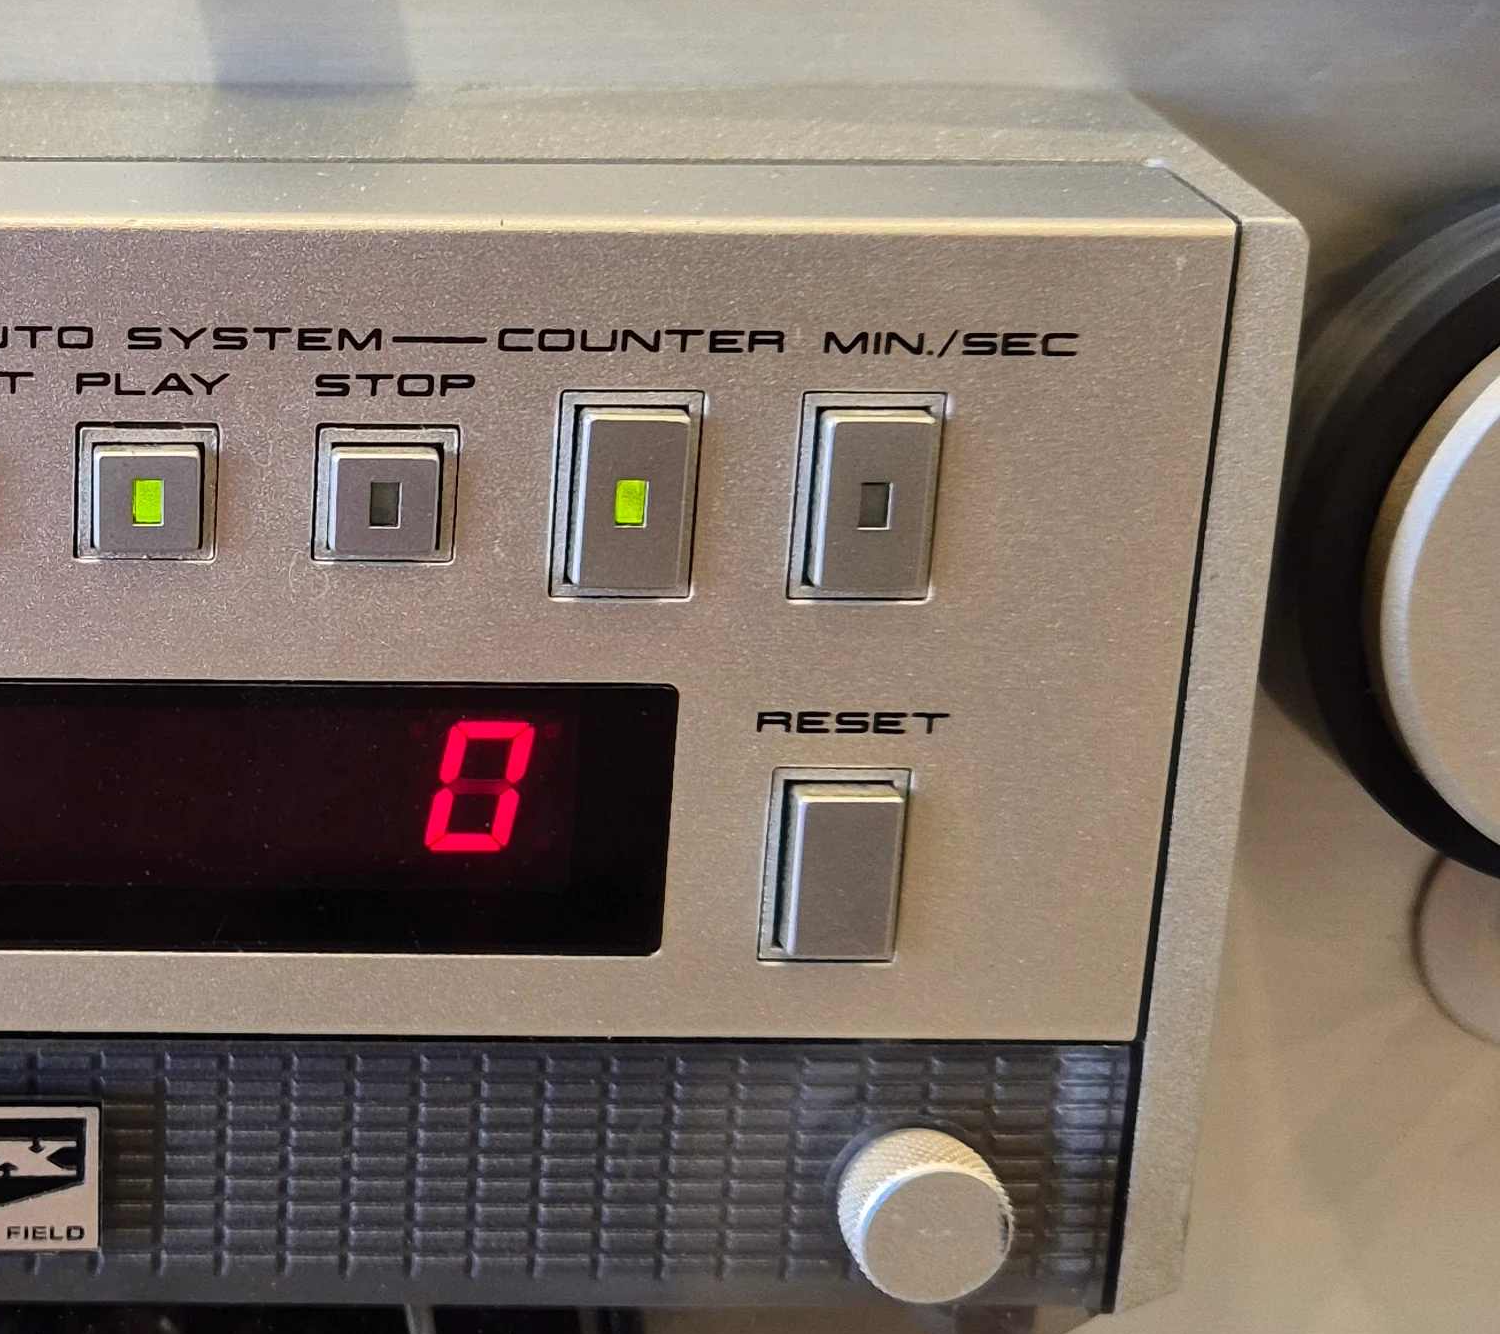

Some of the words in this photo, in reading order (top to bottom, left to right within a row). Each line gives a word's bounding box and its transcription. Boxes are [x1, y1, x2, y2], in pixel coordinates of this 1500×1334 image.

[128, 327, 383, 351] SYSTEM
[497, 328, 785, 354] COUNTER
[824, 330, 1080, 357] MIN./SEC
[75, 372, 231, 396] PLAY
[315, 374, 476, 397] STOP
[756, 712, 951, 735] RESET
[425, 721, 535, 854] 0
[6, 1225, 86, 1242] FIELD
